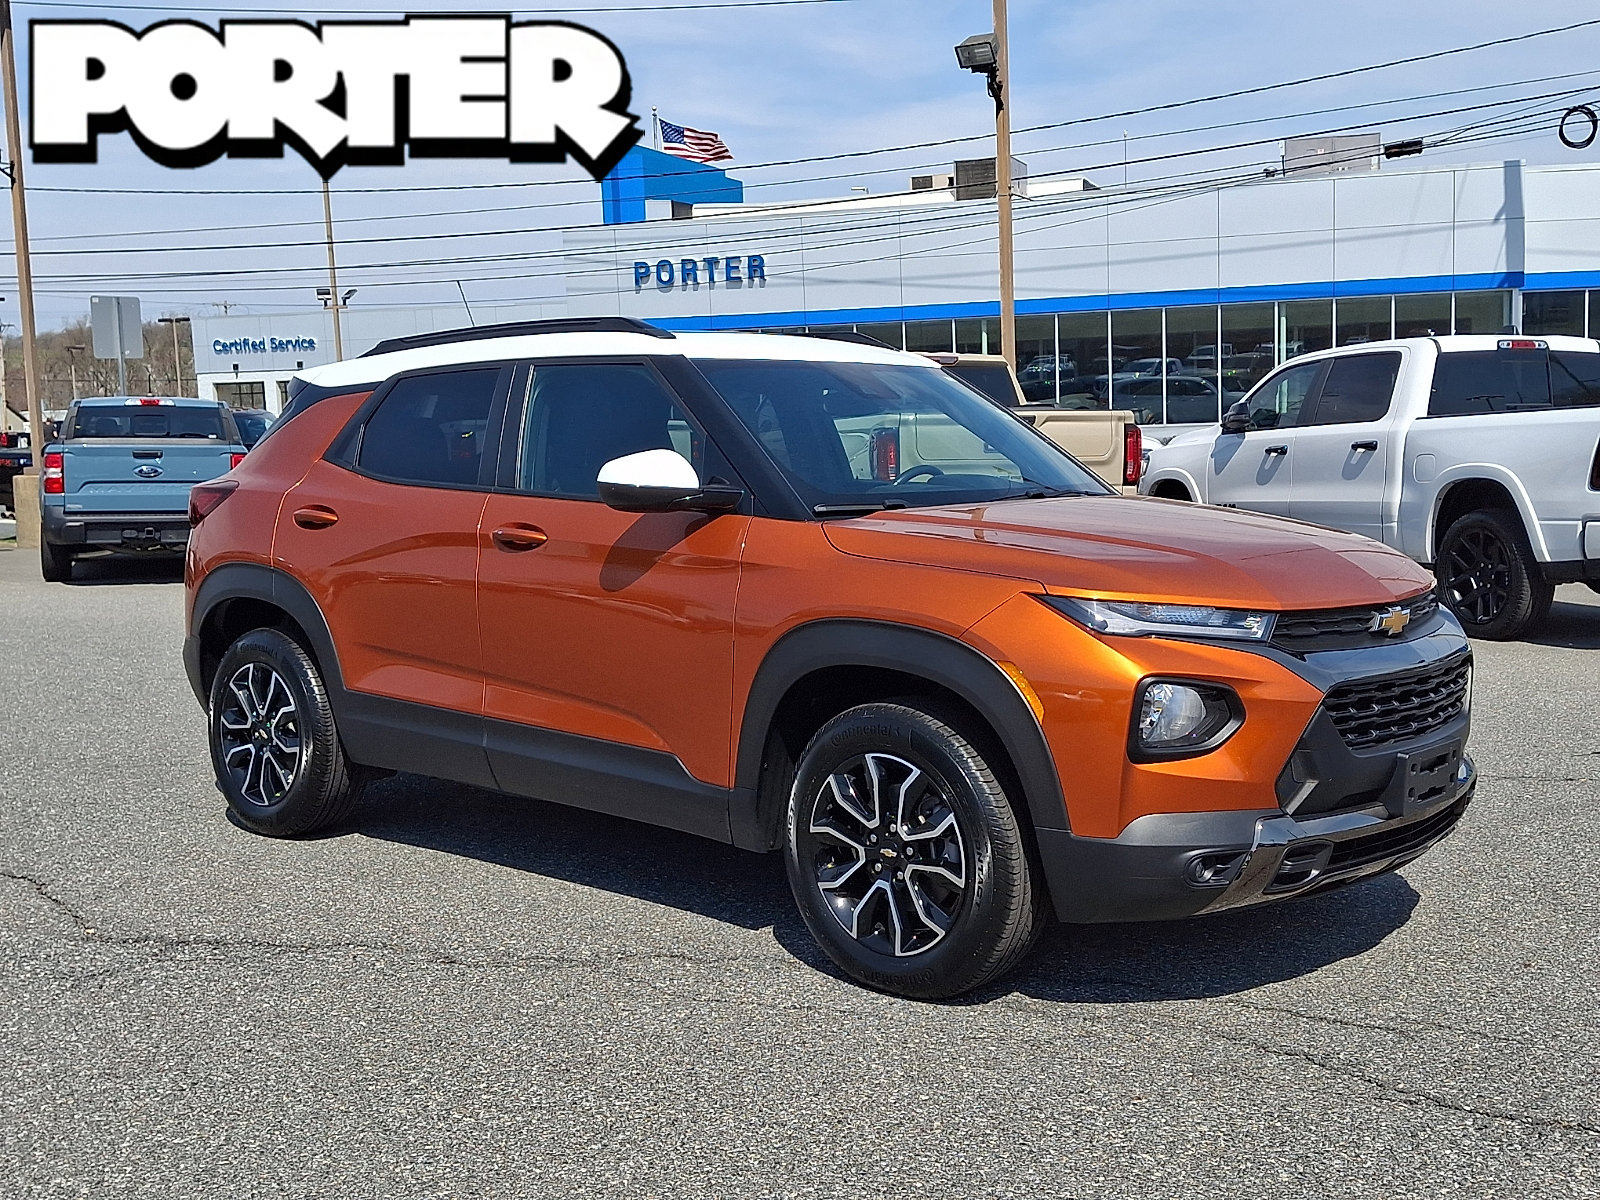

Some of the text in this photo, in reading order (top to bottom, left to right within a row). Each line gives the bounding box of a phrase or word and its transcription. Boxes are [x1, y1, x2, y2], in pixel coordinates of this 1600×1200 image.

[633, 254, 766, 287] PORTER
[212, 336, 317, 353] Certified Service
